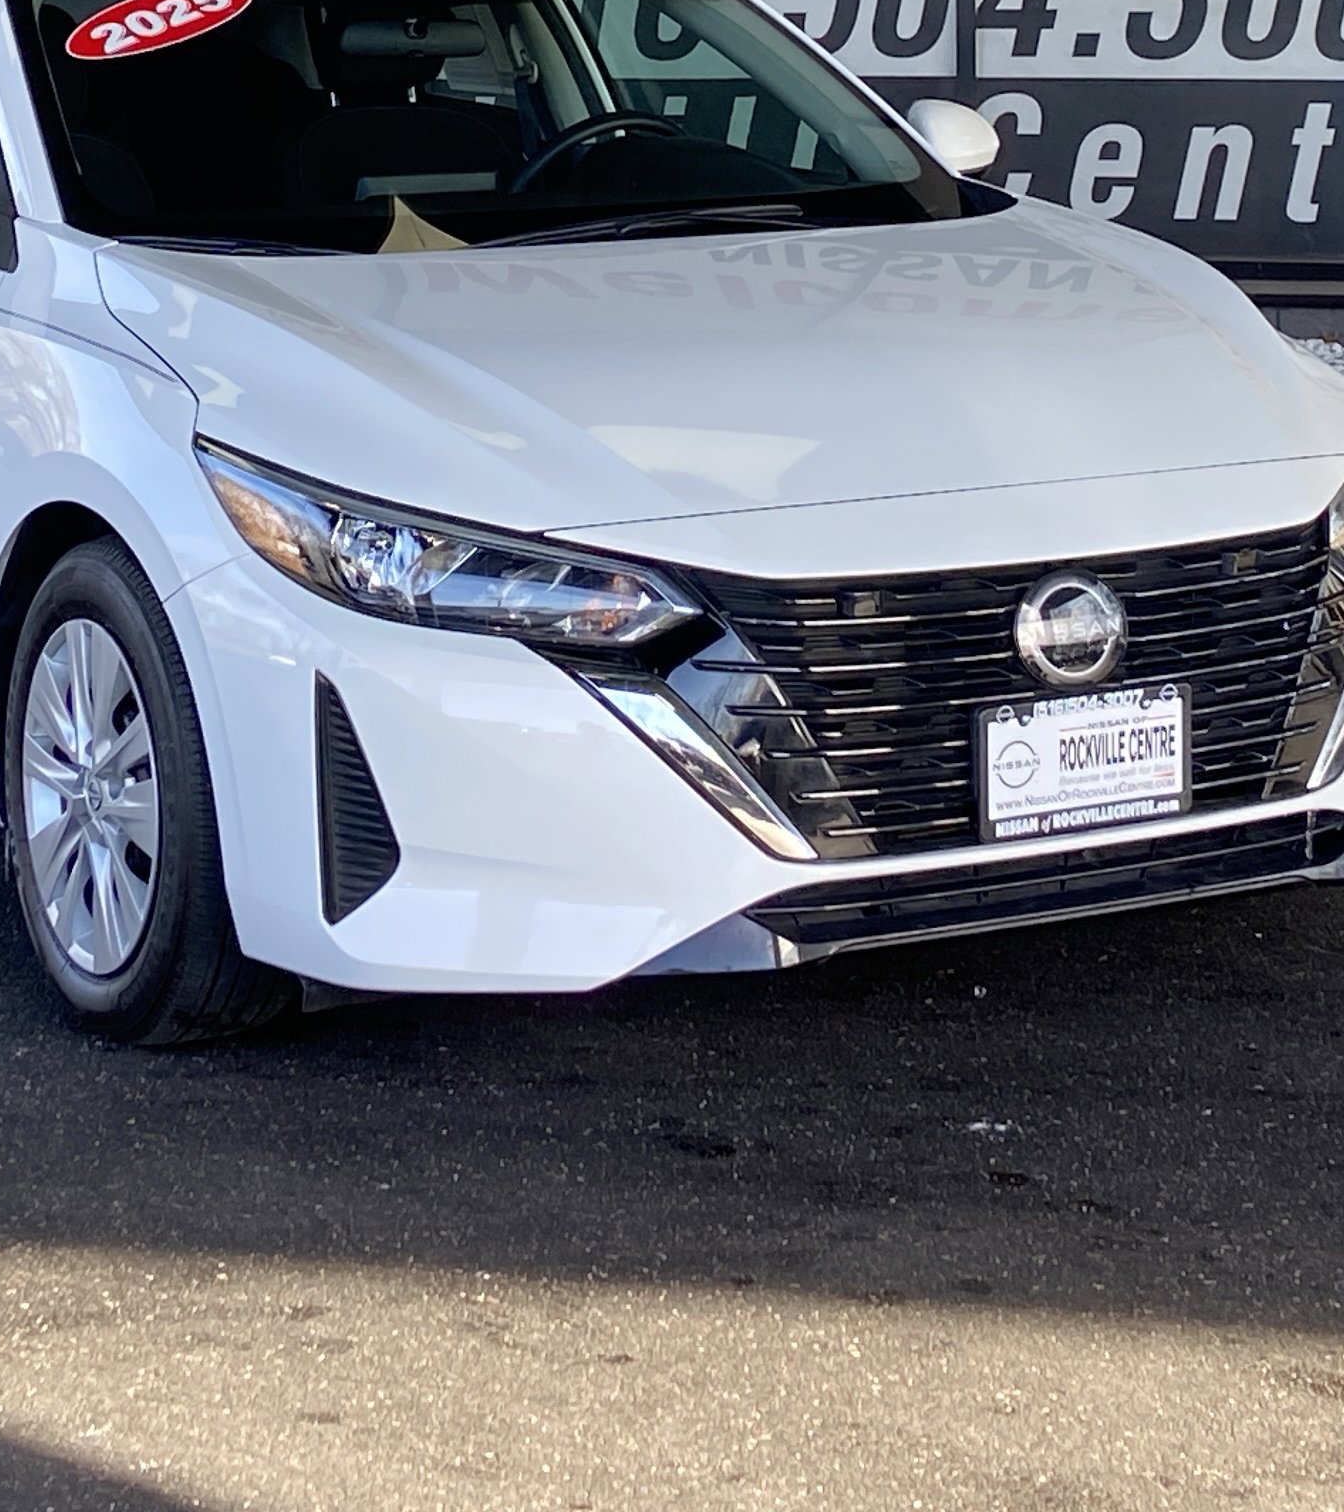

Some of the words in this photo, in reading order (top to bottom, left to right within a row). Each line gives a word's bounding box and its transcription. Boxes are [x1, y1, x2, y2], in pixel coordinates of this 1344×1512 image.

[1058, 732, 1125, 772] ROCKVILLE
[1128, 724, 1175, 763] CENTRE
[992, 758, 1041, 772] NISSAN
